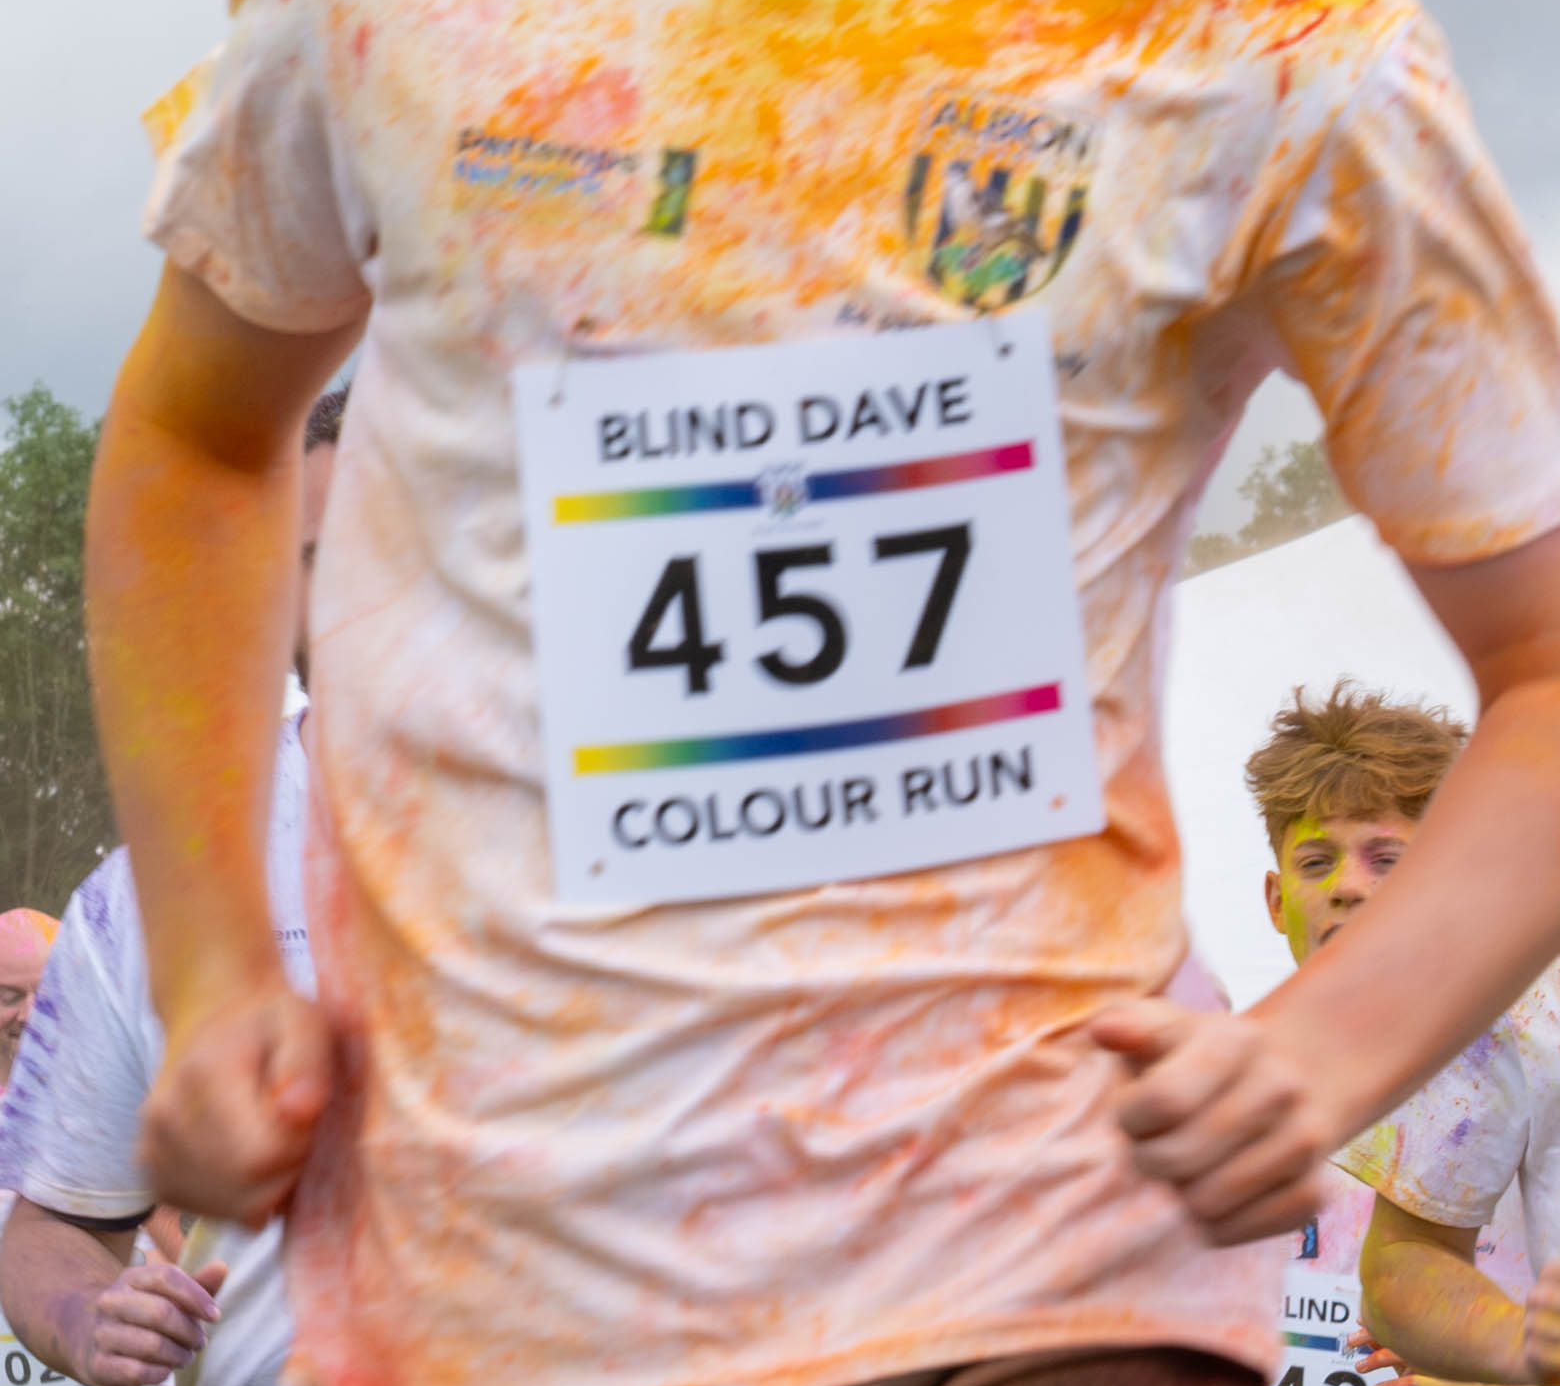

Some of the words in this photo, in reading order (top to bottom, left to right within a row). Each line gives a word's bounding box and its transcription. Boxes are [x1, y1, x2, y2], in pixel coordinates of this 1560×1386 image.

[597, 402, 776, 465] BLIND
[799, 376, 974, 447] DAVE
[625, 518, 975, 698] 457
[612, 775, 881, 850] COLOUR
[901, 745, 1036, 805] RUN
[1284, 1296, 1350, 1324] LIND
